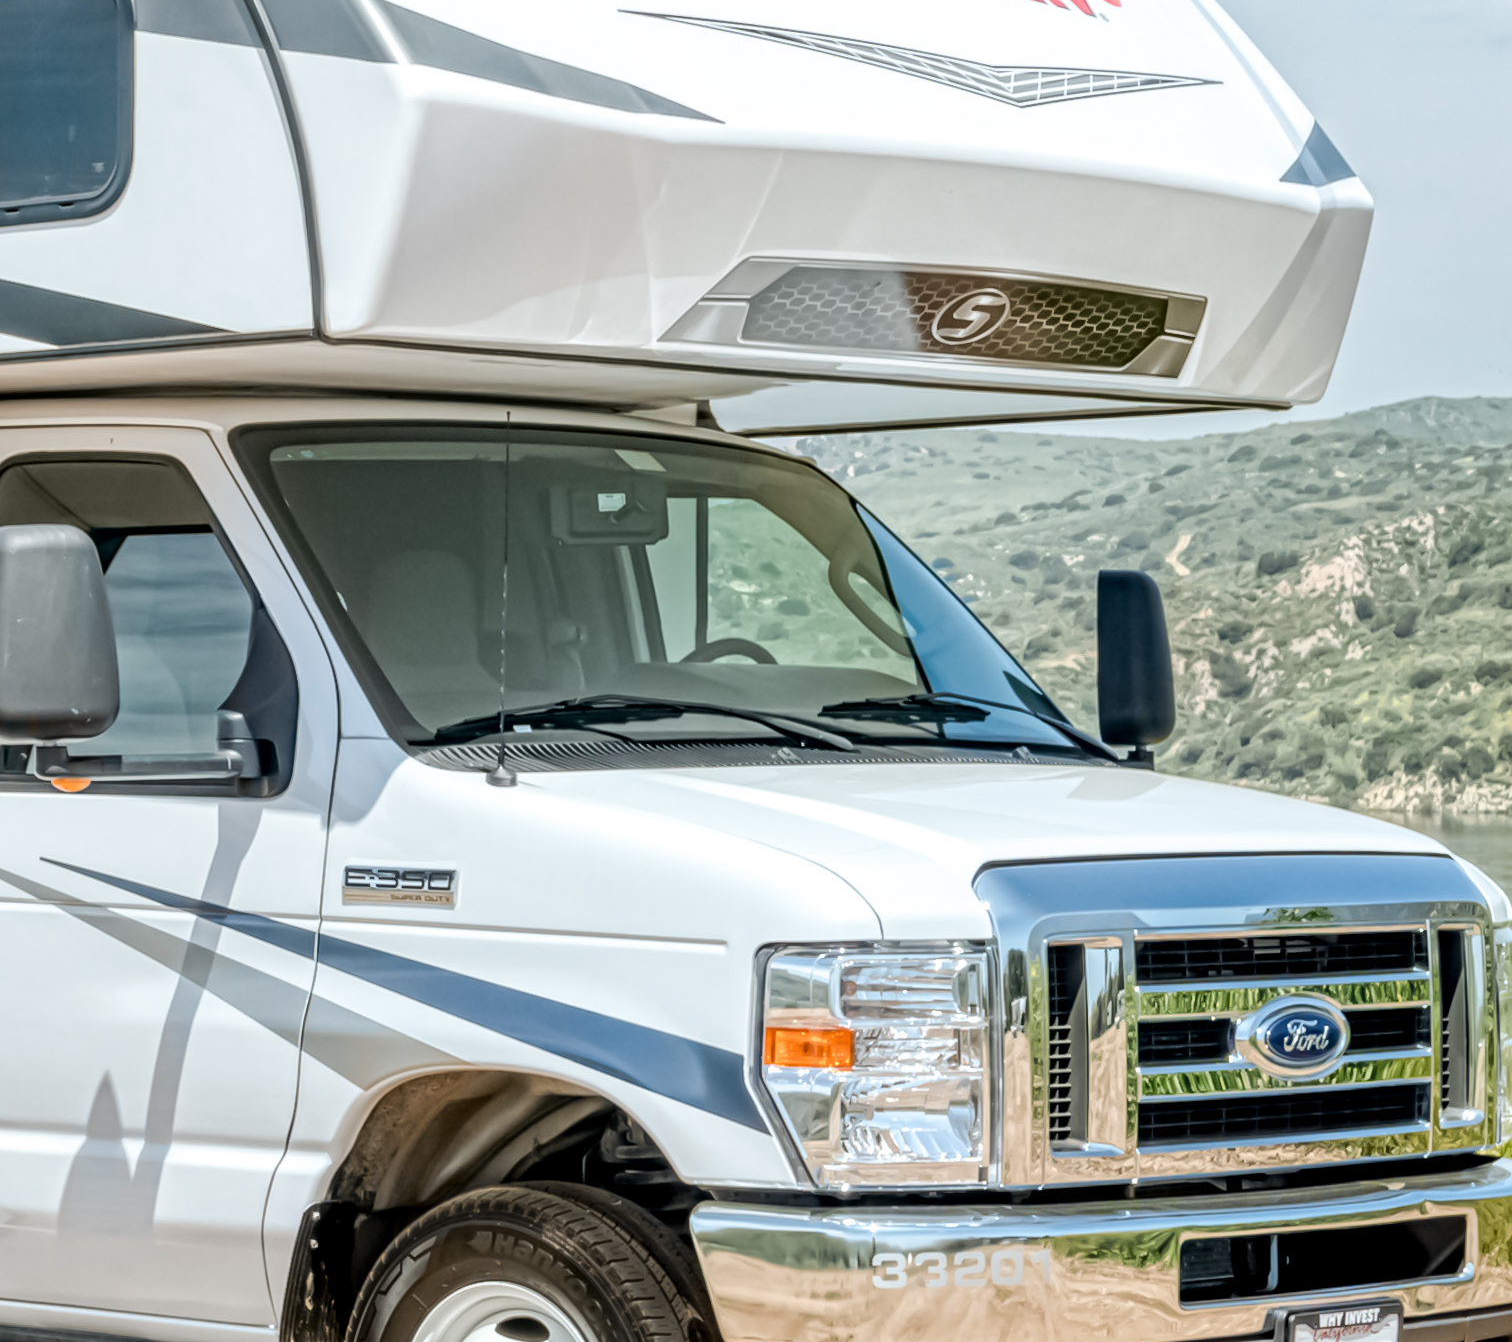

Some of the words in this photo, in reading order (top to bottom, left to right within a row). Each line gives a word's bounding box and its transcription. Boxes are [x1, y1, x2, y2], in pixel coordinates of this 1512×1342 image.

[390, 893, 422, 901] SUPER
[424, 894, 451, 903] DUTY
[1284, 1019, 1329, 1052] Ford
[872, 1249, 1052, 1290] 33201
[1319, 1312, 1344, 1328] WHY
[1345, 1308, 1380, 1325] INVEST
